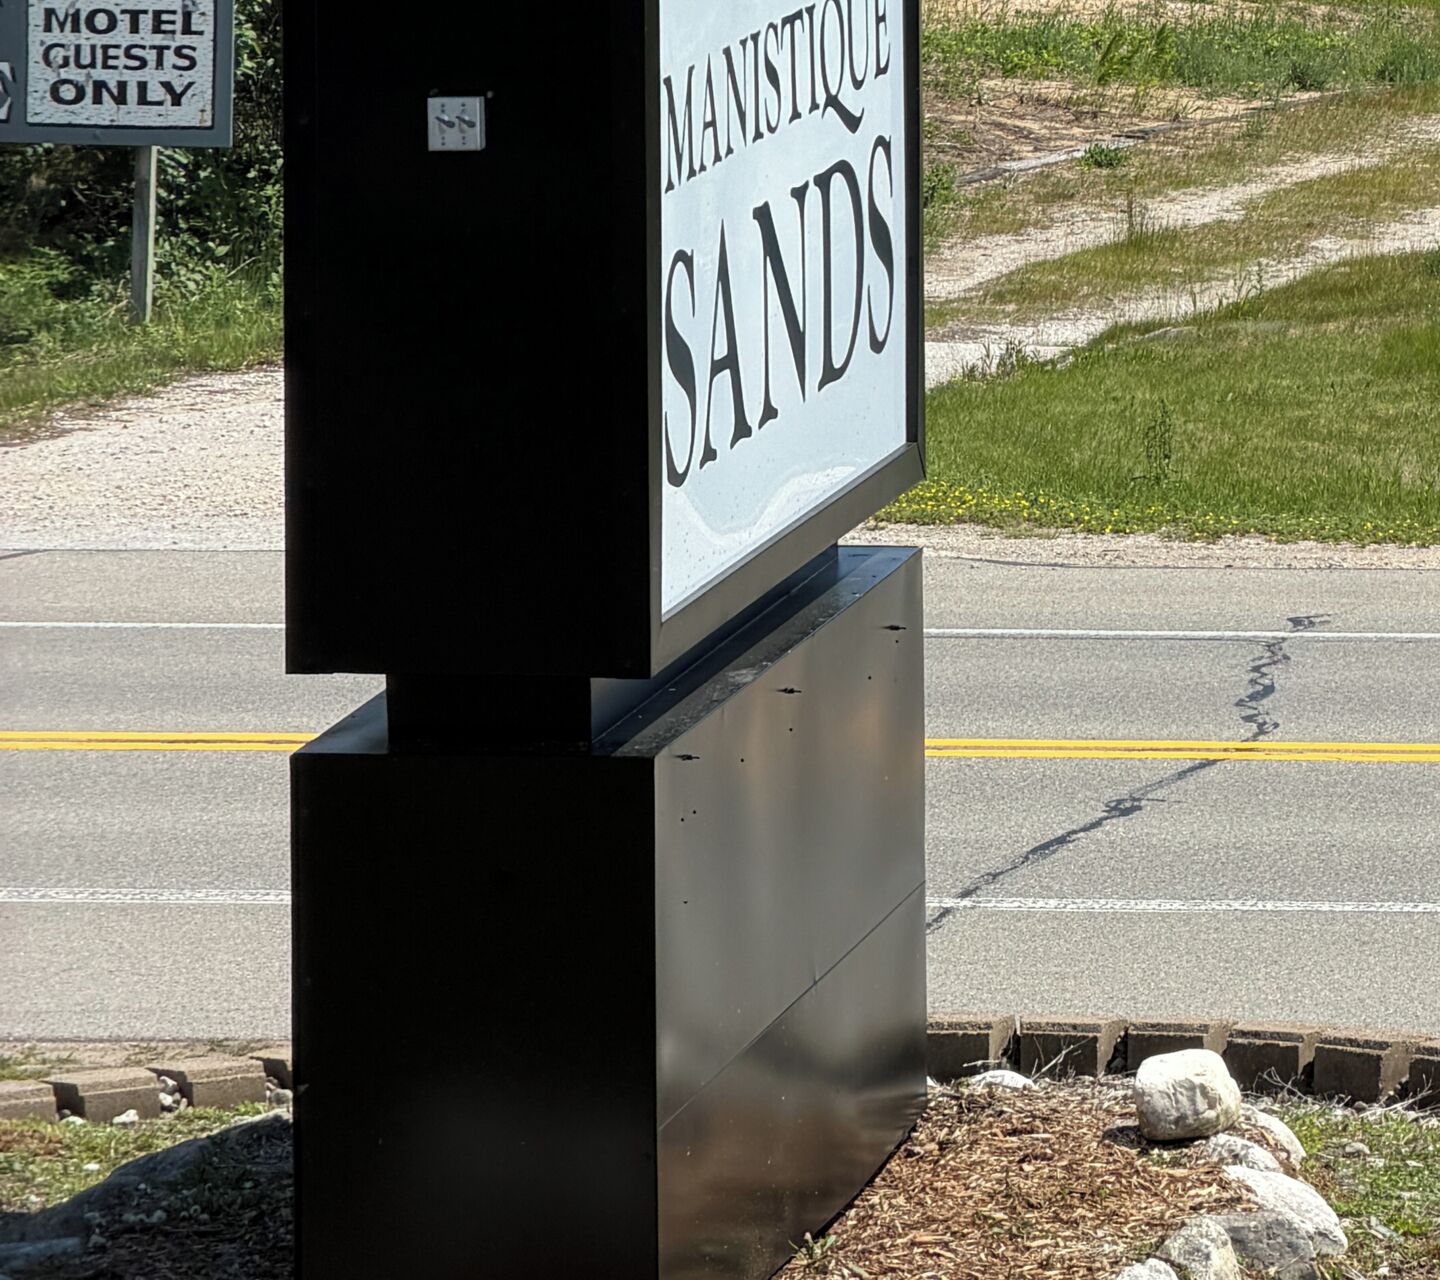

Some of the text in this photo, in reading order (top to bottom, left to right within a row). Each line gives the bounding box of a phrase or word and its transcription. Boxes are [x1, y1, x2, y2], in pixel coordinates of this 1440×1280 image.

[43, 7, 205, 36] MOTEL
[42, 43, 197, 71] GUESTS
[50, 79, 196, 107] ONLY
[664, 135, 894, 487] SANDS
